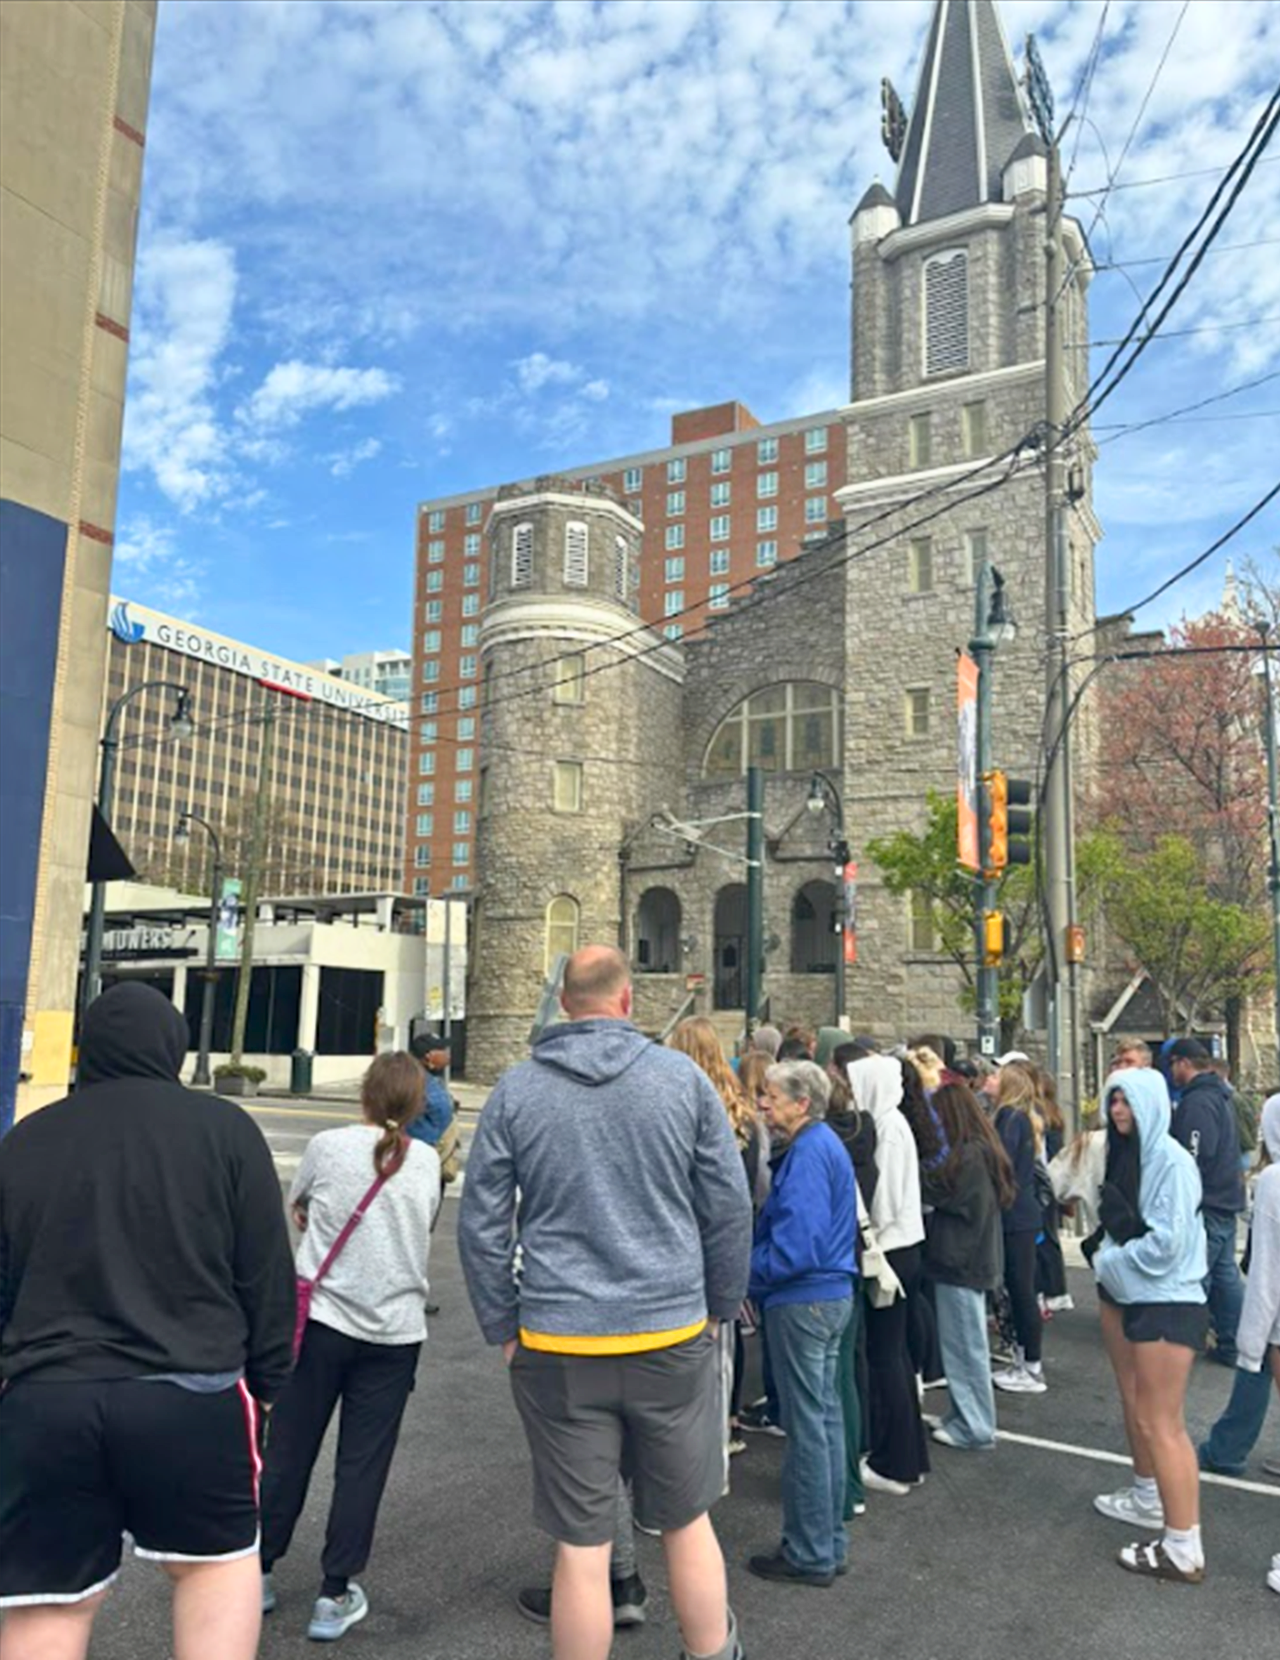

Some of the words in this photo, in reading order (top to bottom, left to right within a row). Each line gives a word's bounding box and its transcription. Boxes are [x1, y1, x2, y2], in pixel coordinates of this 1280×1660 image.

[157, 624, 251, 671] GEORGIA
[261, 660, 313, 692] STATE
[322, 682, 406, 724] UNIVERSIT
